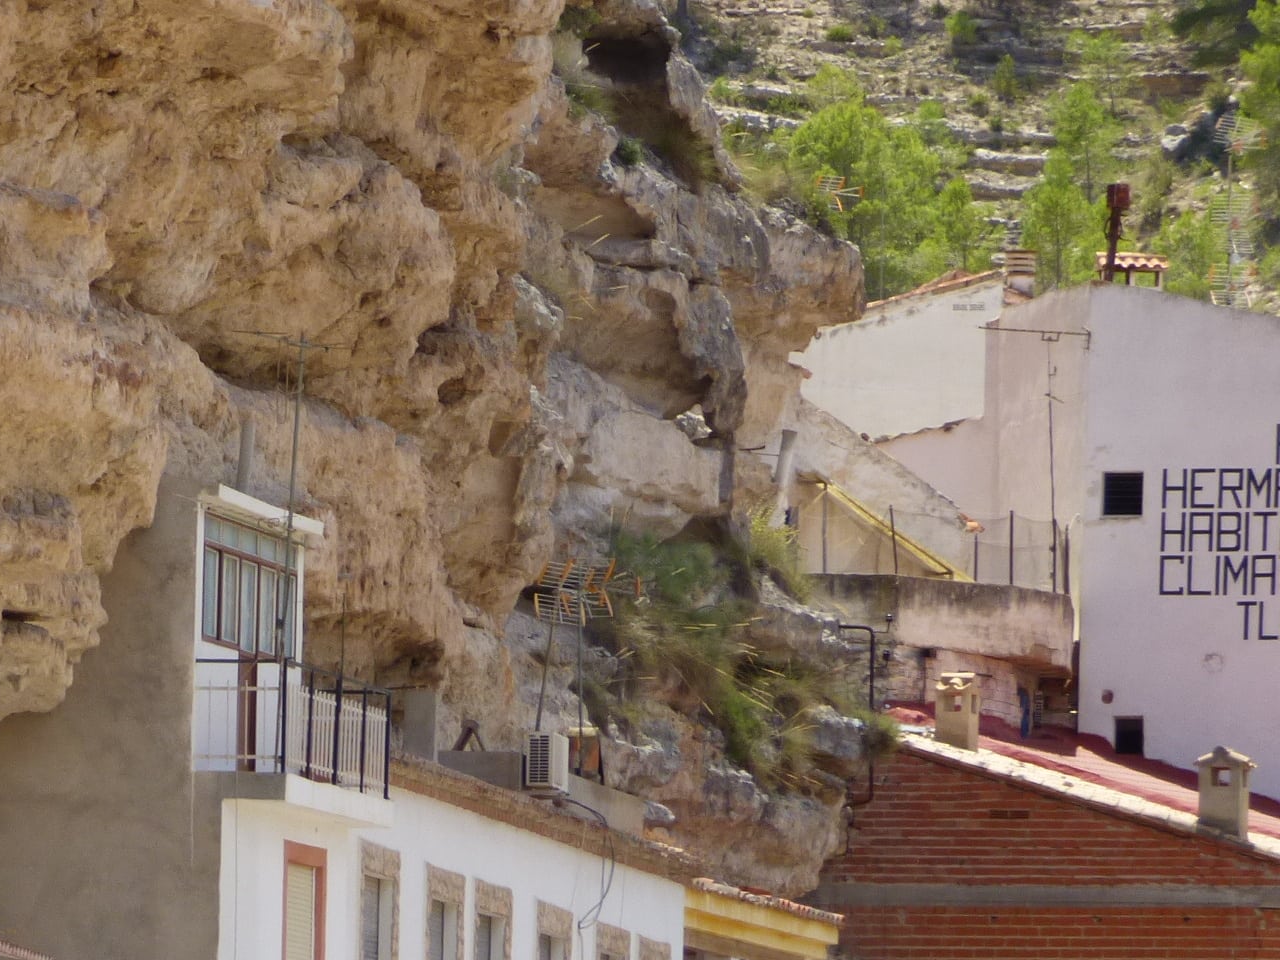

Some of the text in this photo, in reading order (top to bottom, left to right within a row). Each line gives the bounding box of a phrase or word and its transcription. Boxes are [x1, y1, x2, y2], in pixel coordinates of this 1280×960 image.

[1161, 468, 1280, 509] HERM
[1160, 511, 1278, 552] HABIT
[1159, 554, 1277, 596] CLIMA
